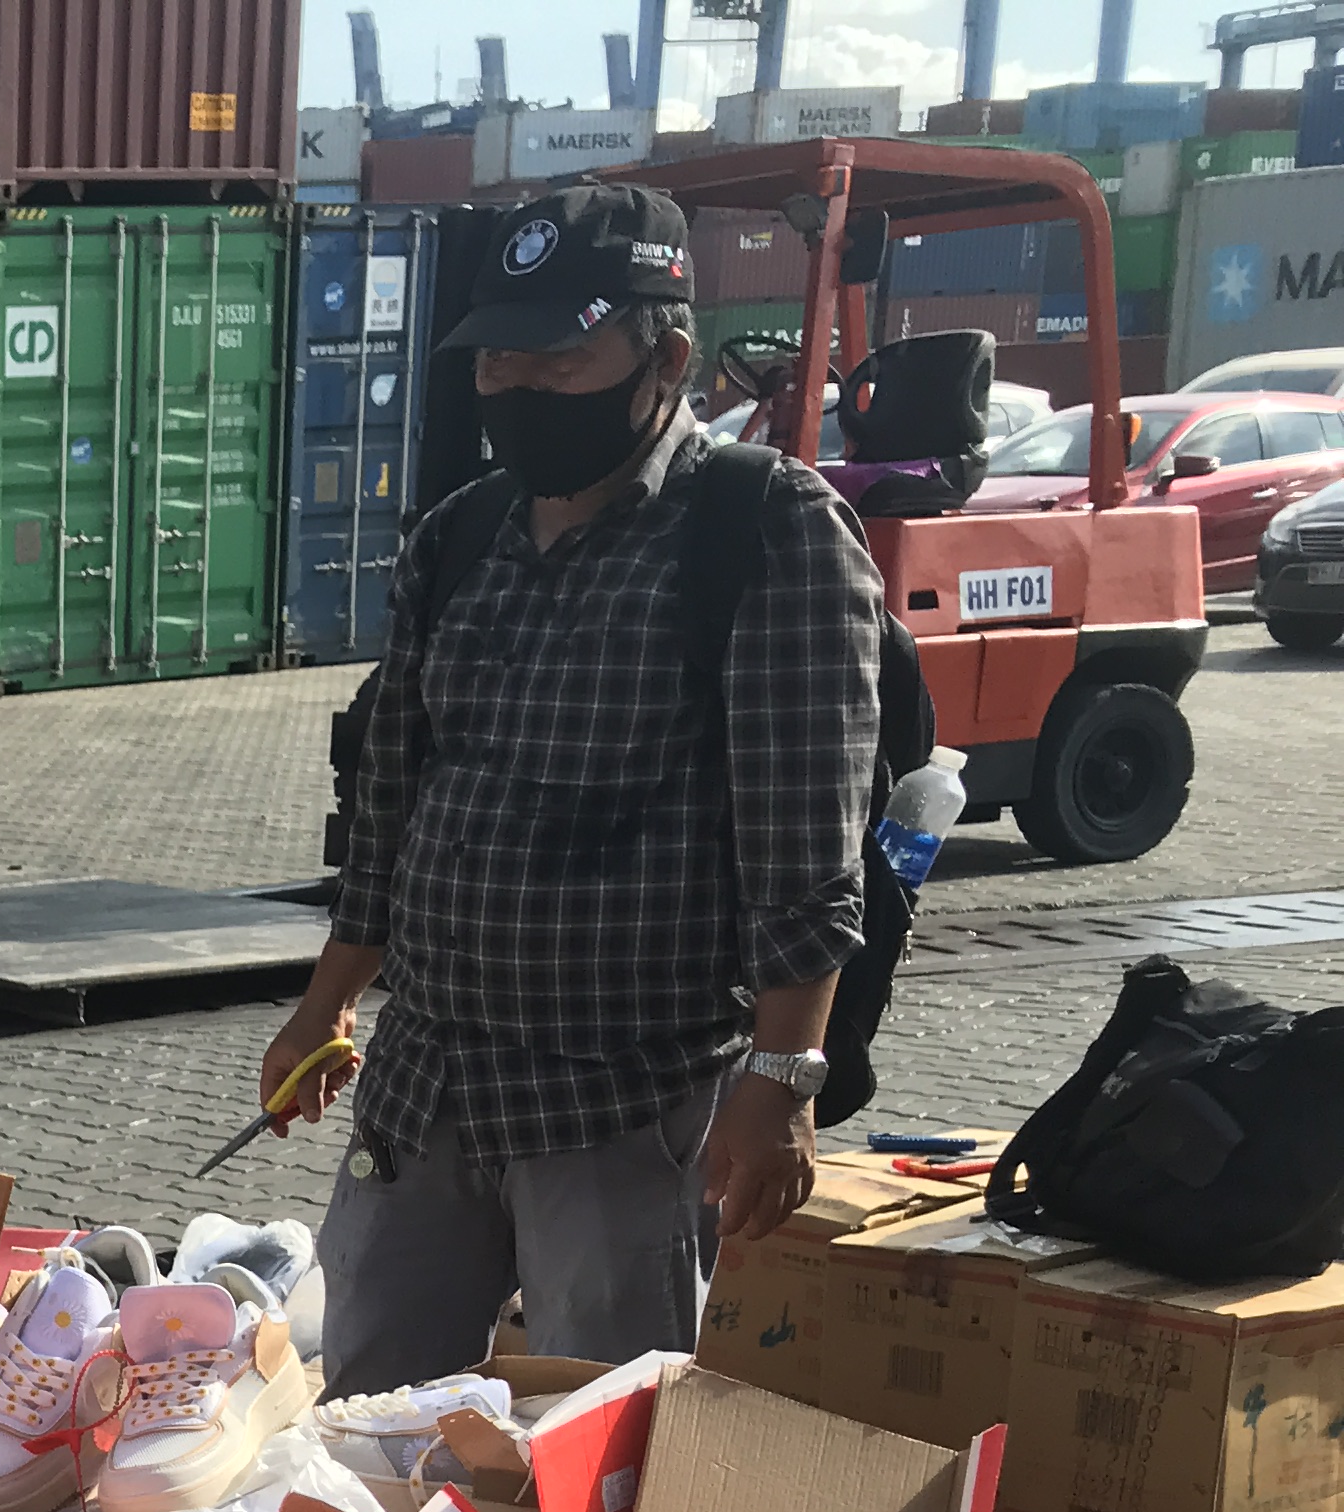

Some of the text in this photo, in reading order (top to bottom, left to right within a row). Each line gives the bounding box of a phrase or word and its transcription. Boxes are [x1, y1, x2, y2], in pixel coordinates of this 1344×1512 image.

[547, 132, 632, 150] MAERSK
[967, 574, 1047, 611] HH F01
